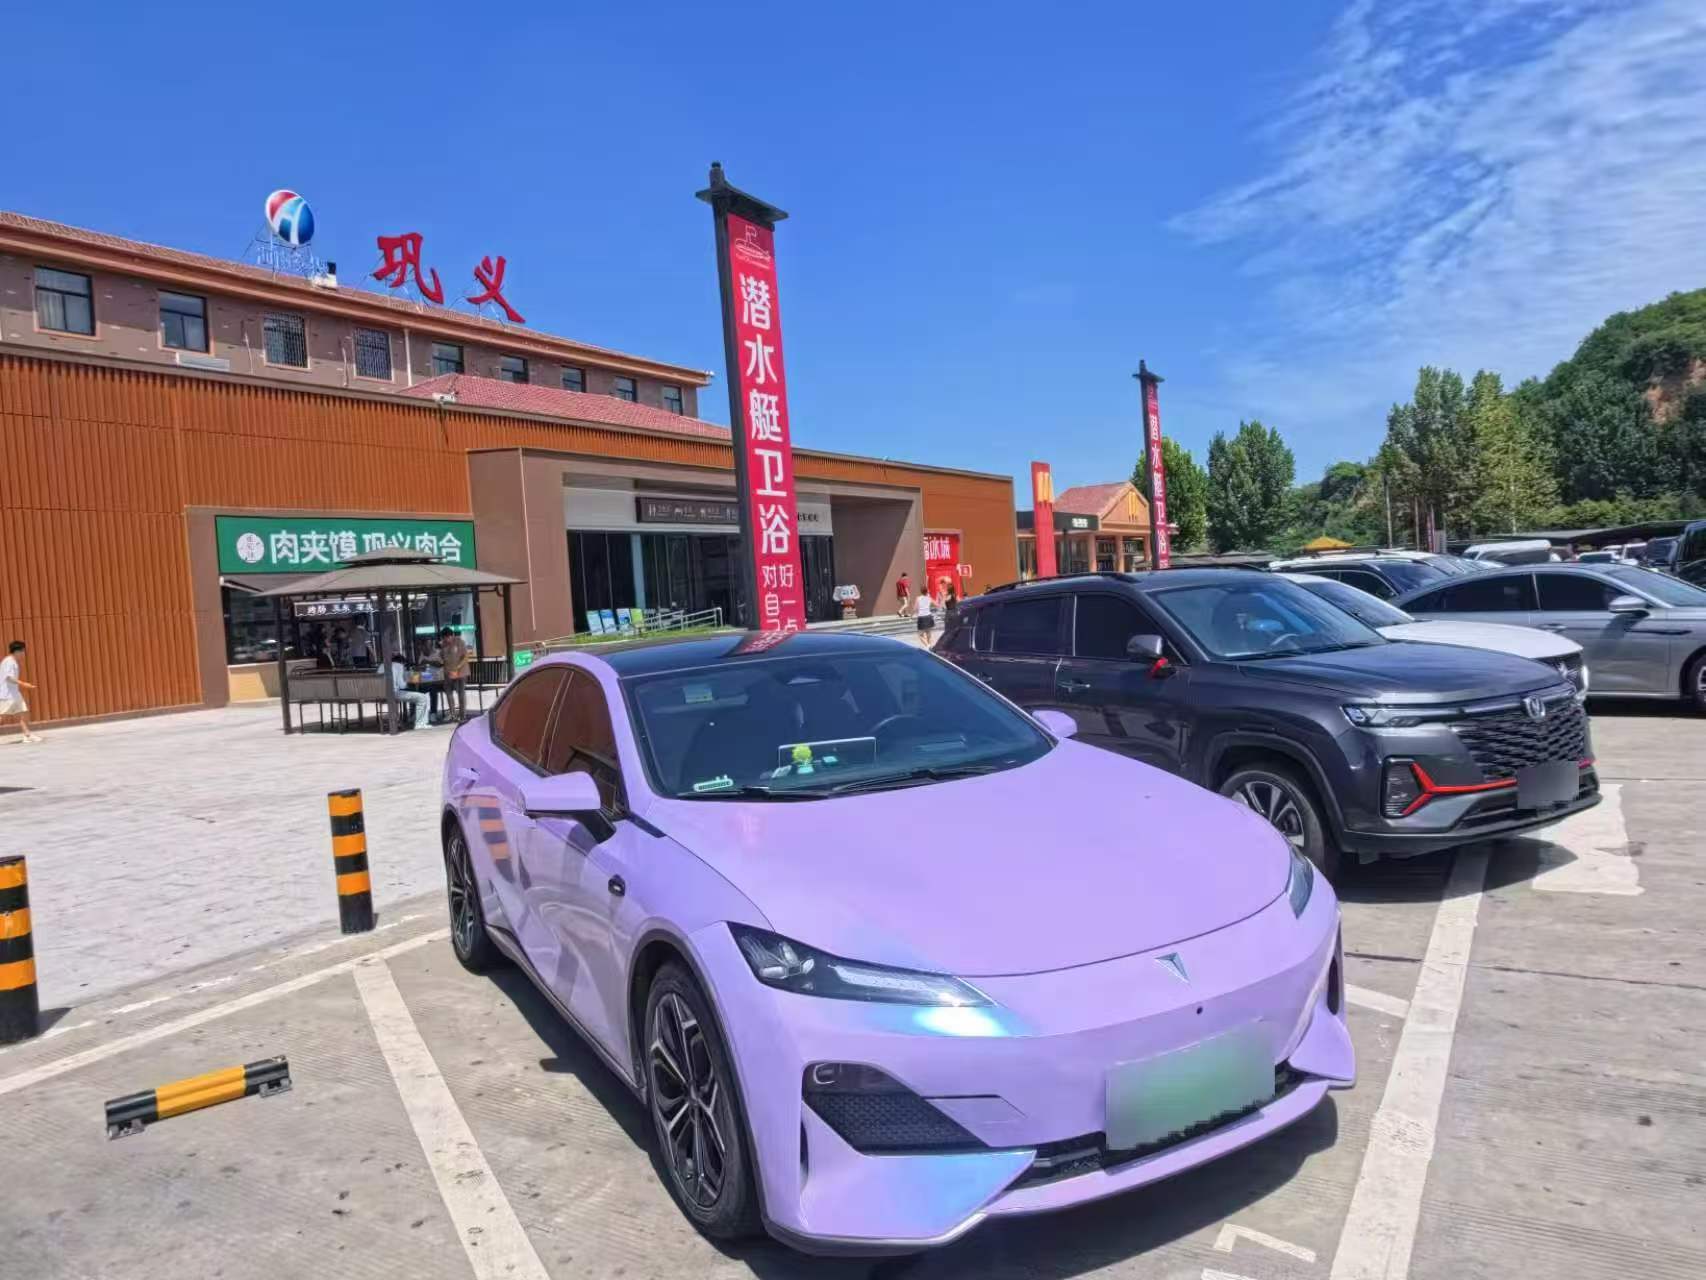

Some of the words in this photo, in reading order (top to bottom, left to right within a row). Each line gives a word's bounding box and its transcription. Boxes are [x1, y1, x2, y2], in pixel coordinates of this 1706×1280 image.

[372, 232, 526, 324] 巩义
[740, 272, 791, 554] 潜水艇卫浴
[270, 531, 358, 564] 肉夹馍
